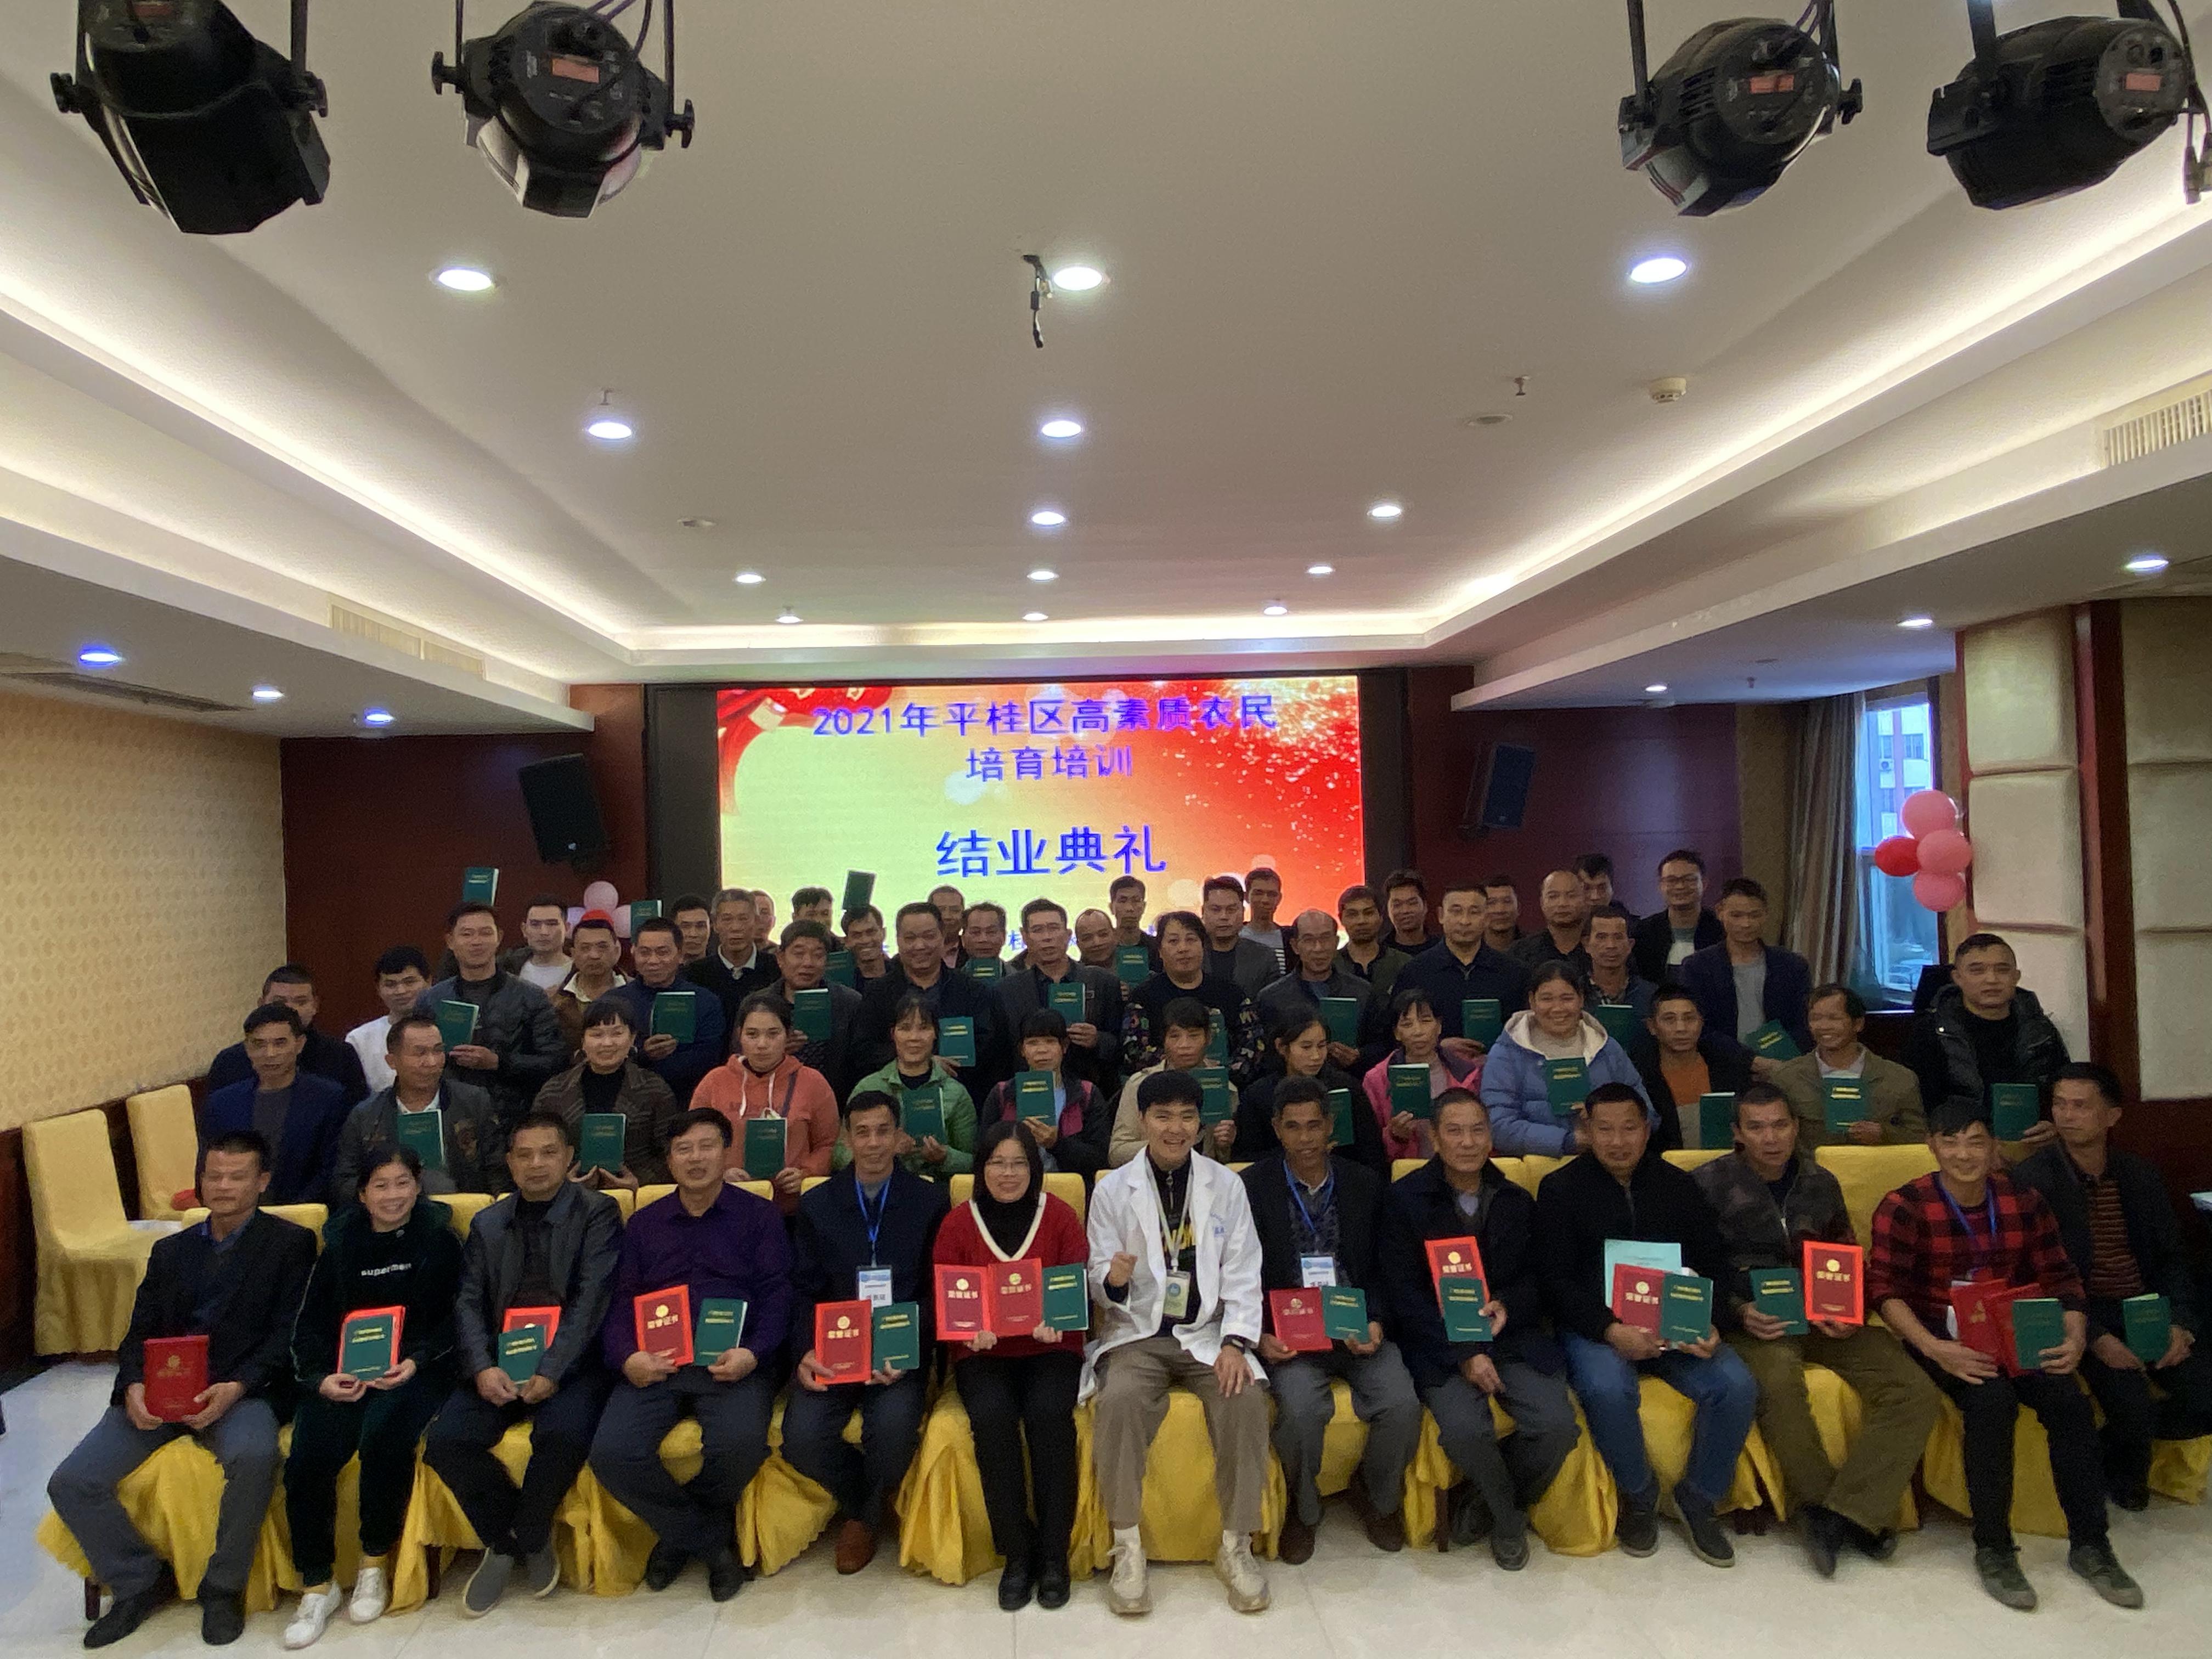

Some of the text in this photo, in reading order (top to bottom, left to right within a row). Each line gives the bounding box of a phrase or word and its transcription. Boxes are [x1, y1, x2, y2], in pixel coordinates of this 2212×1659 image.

[812, 695, 1277, 738] 2021年平桂区高素质农民
[965, 744, 1132, 782] 培育培训
[935, 825, 1167, 878] 结业典礼
